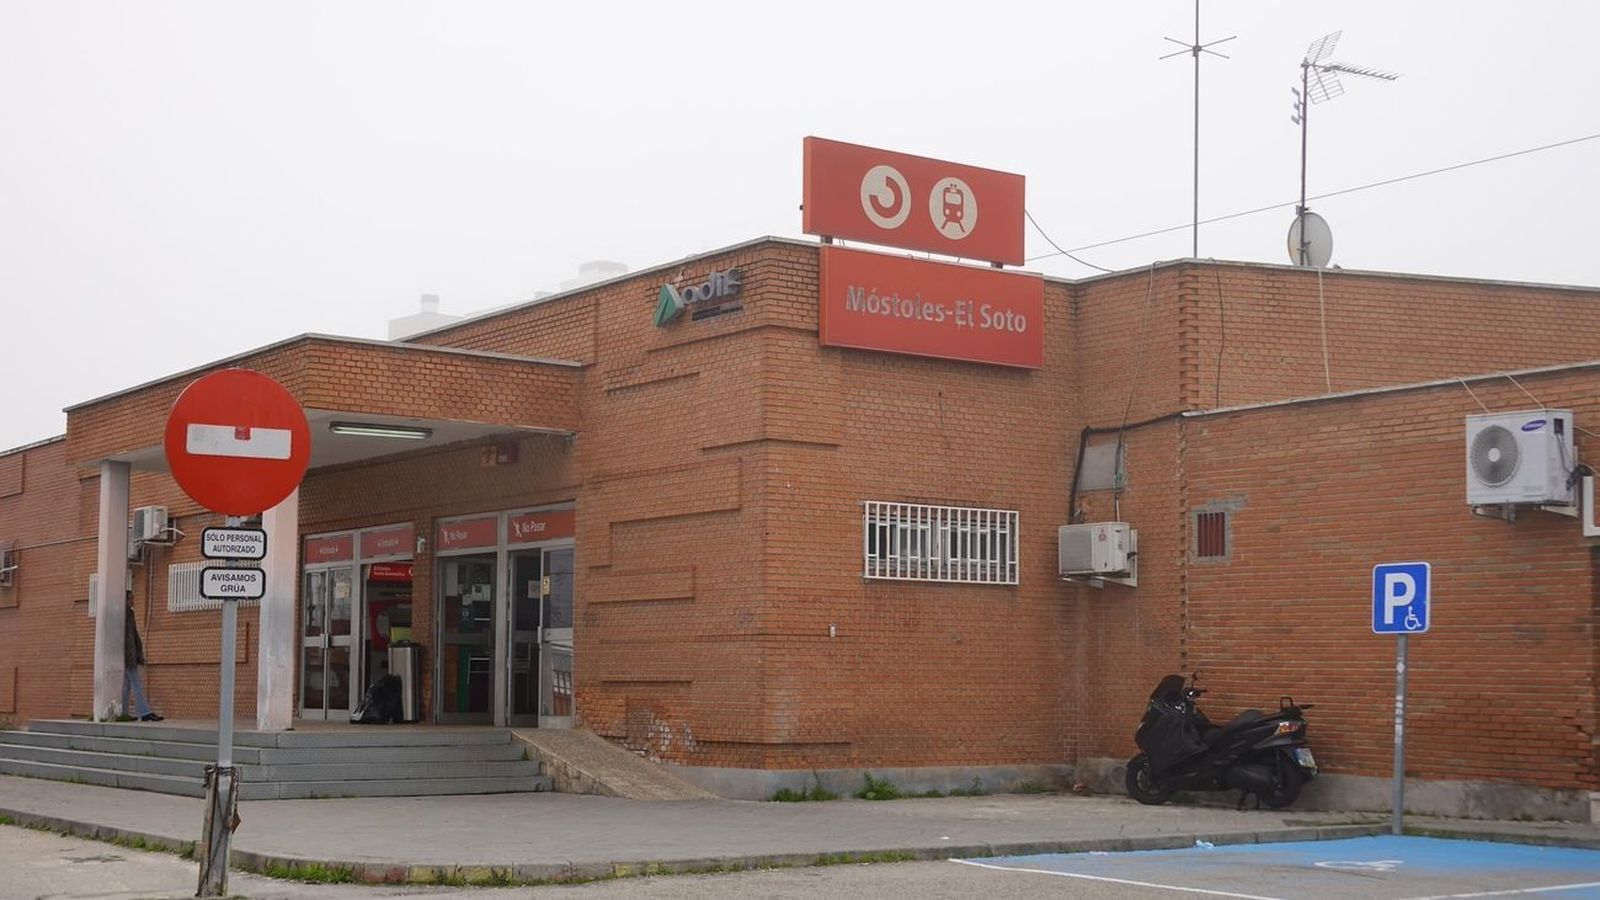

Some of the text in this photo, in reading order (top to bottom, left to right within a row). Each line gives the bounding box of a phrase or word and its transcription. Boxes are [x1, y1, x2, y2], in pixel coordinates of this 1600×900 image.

[846, 285, 1027, 333] Móstoles-El Soto
[206, 531, 263, 543] SÓLO PERSONAL
[212, 544, 256, 554] AUTORIZADO
[211, 573, 257, 582] AVISAMOS
[220, 582, 246, 593] GRÚA
[1384, 572, 1416, 625] P
